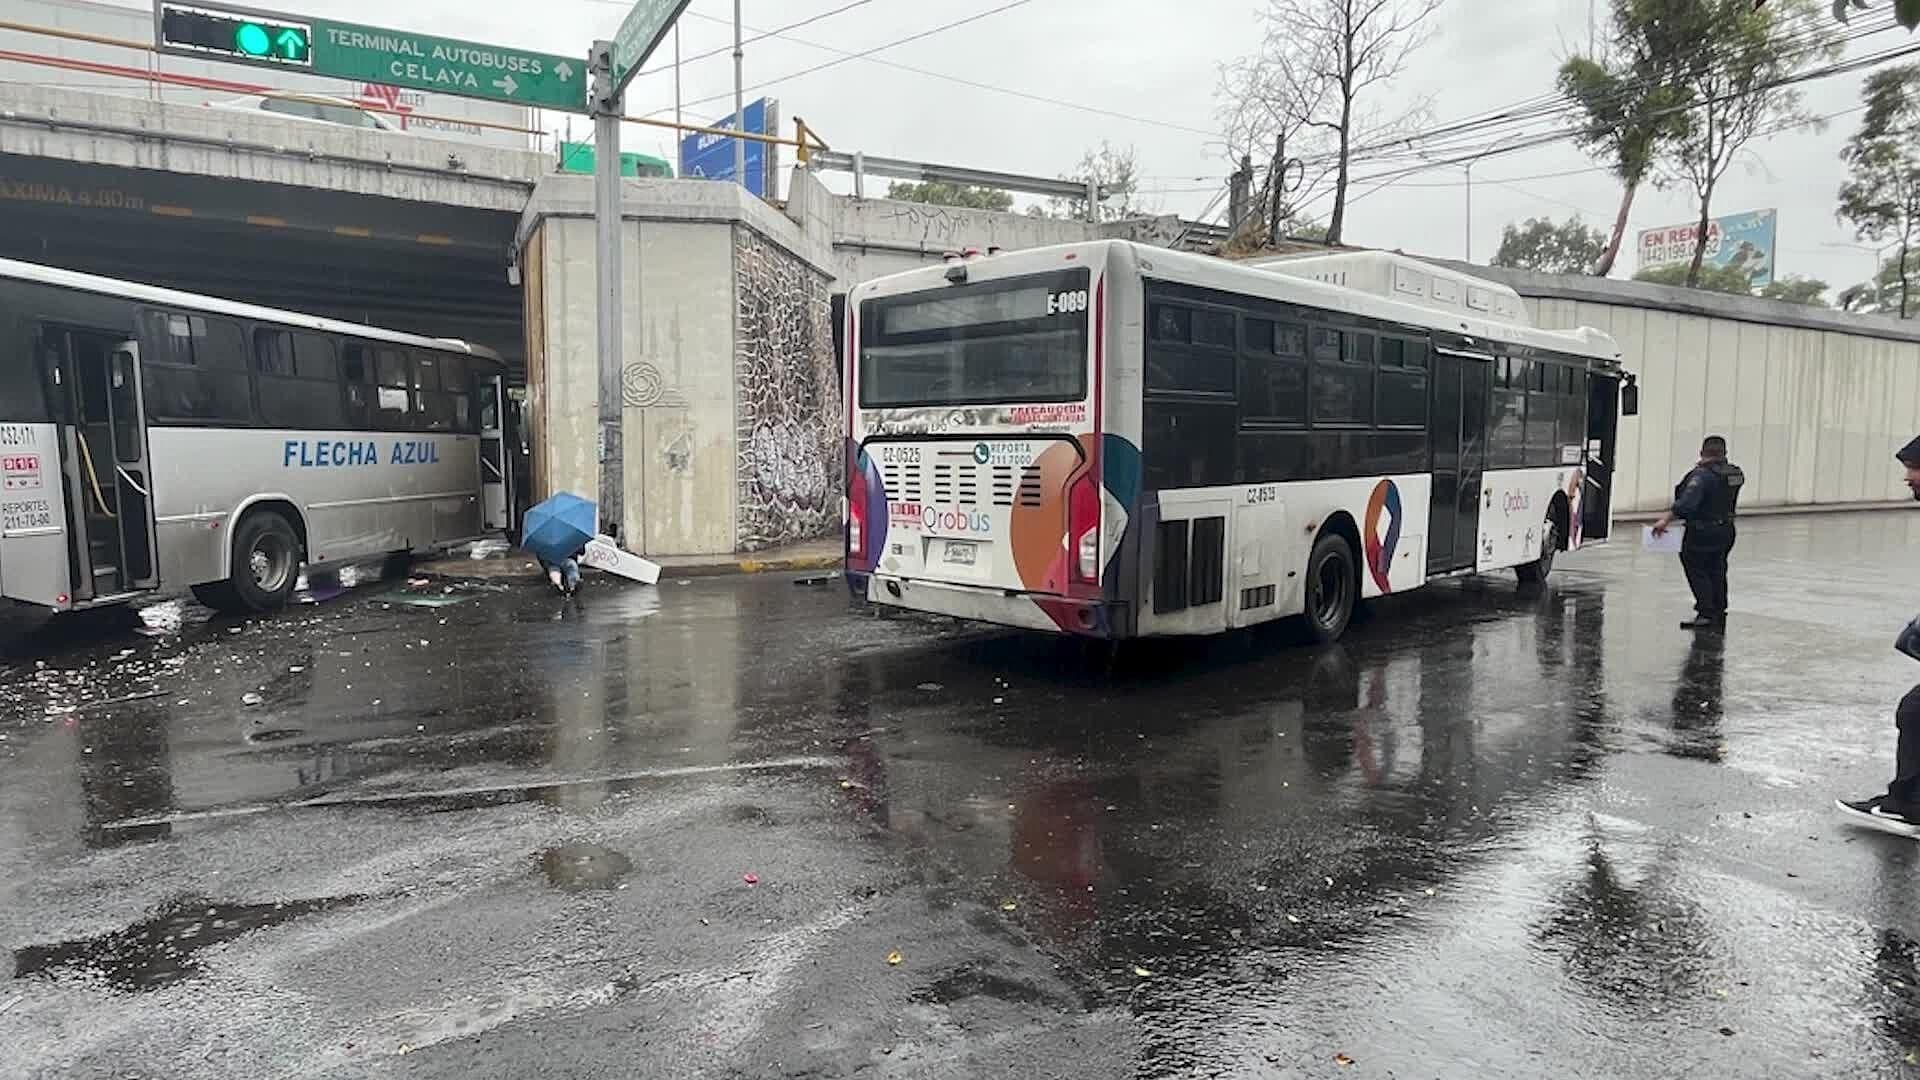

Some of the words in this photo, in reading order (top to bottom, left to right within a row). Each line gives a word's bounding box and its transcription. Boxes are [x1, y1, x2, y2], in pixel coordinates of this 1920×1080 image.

[327, 28, 424, 57] TERMINAL
[431, 45, 543, 75] AUTOBUSES
[390, 60, 479, 89] CELAYA
[1645, 231, 1665, 248] EN
[1669, 223, 1718, 242] RENA
[1047, 291, 1087, 314] E-089
[284, 440, 378, 468] FLECHA
[391, 440, 441, 465] AZUL
[990, 442, 1032, 454] REPORTA
[2, 499, 49, 514] REPORTES
[923, 504, 991, 535] Qrobús
